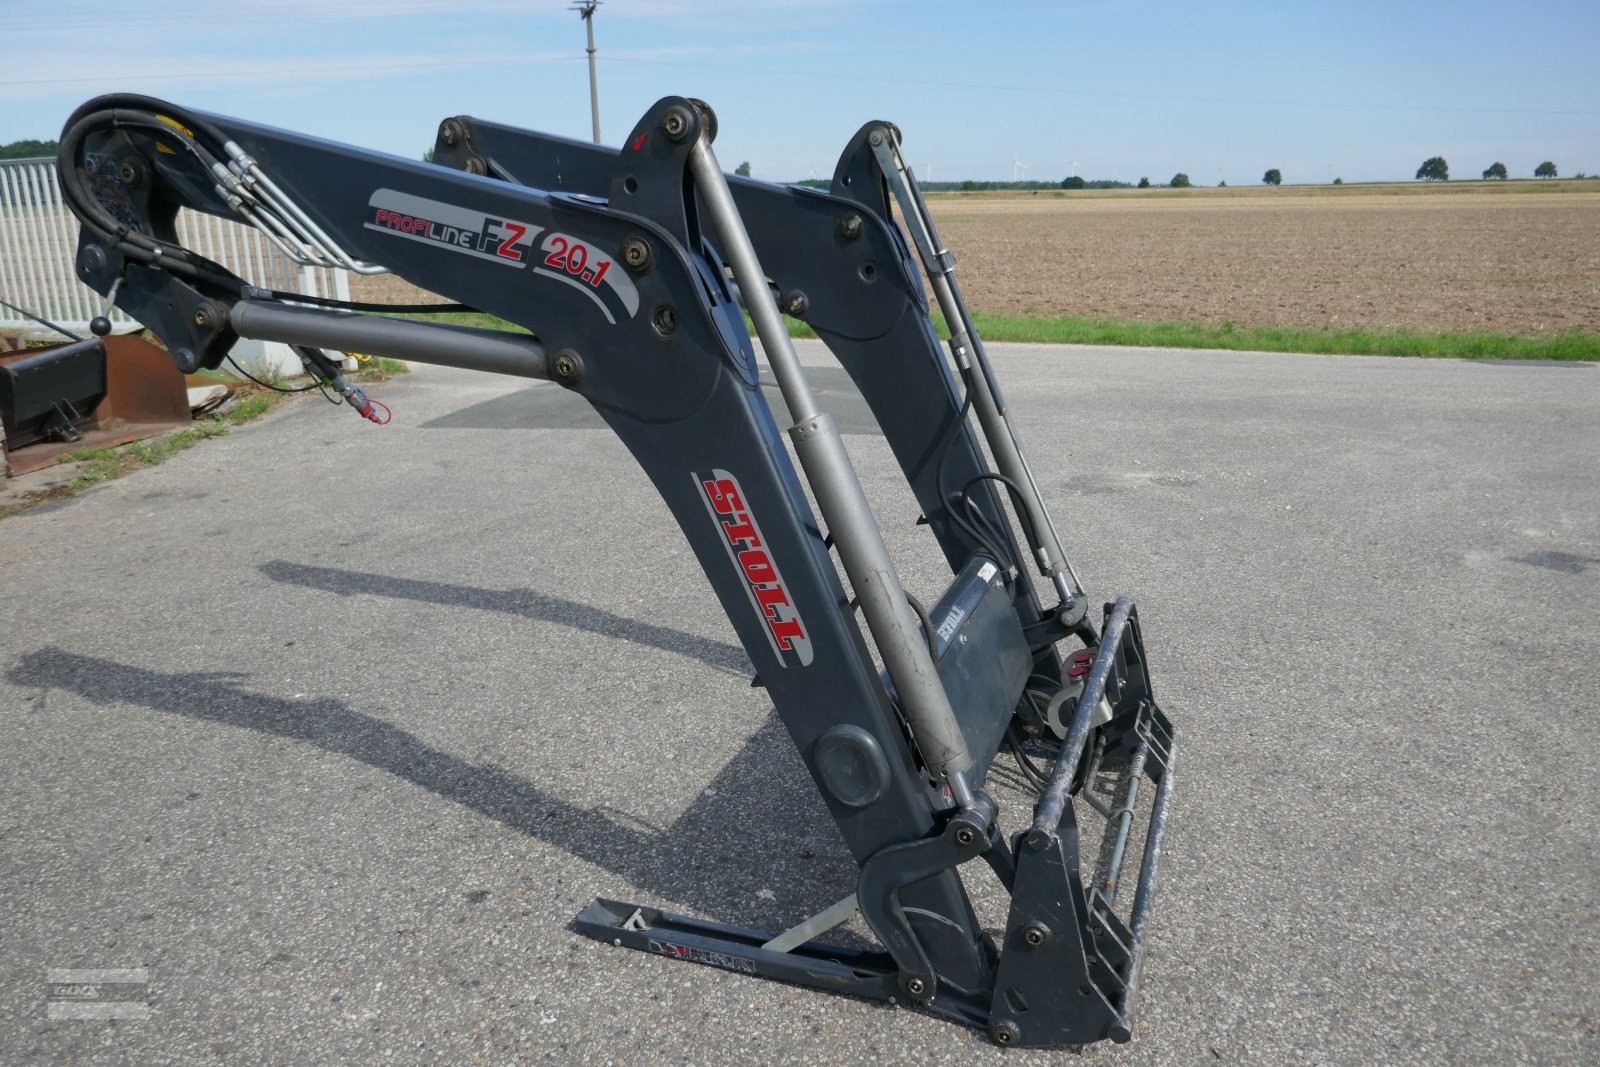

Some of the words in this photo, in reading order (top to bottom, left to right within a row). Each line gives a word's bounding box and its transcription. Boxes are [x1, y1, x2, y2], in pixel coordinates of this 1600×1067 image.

[477, 218, 527, 260] FZ
[544, 236, 612, 287] 20.1
[703, 479, 805, 651] STOLL
[937, 604, 965, 642] STOLL
